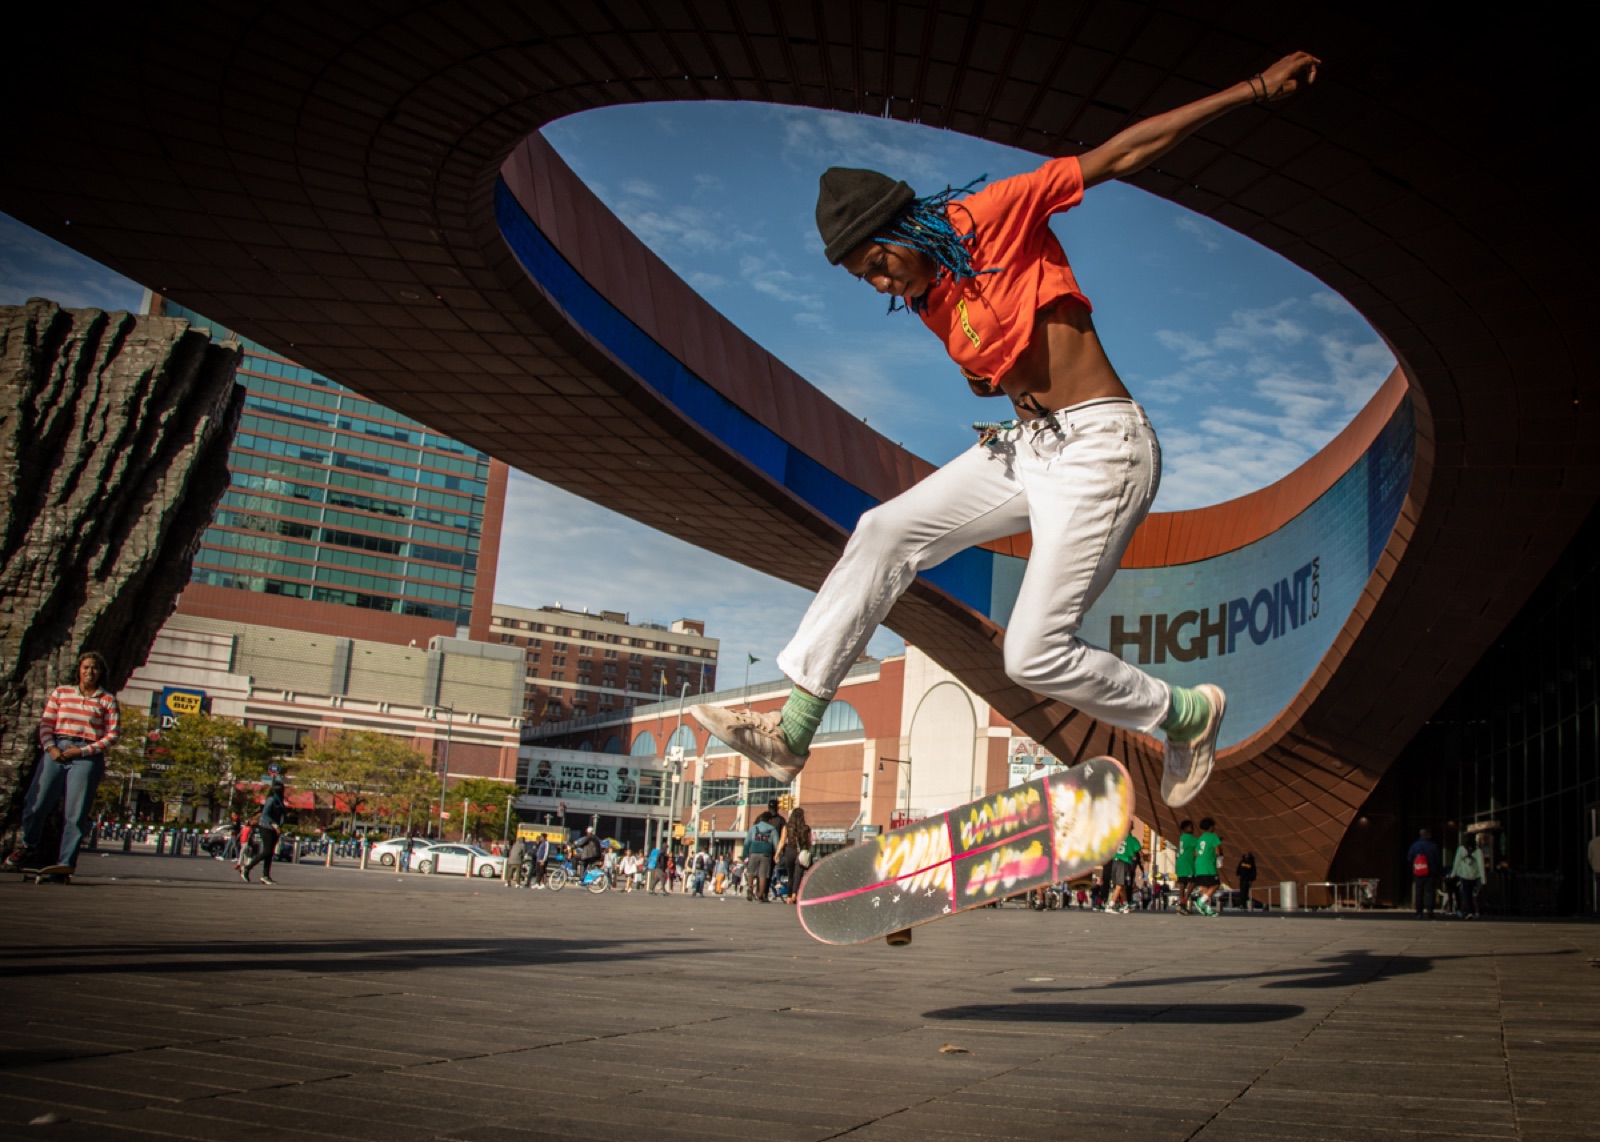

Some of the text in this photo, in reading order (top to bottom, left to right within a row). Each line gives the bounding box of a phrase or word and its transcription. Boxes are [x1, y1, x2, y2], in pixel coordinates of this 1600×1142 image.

[1110, 561, 1313, 665] HIGHPOINT
[172, 695, 200, 704] BEST
[173, 703, 197, 711] BUY
[561, 765, 609, 780] WE GO
[560, 780, 608, 795] HARD
